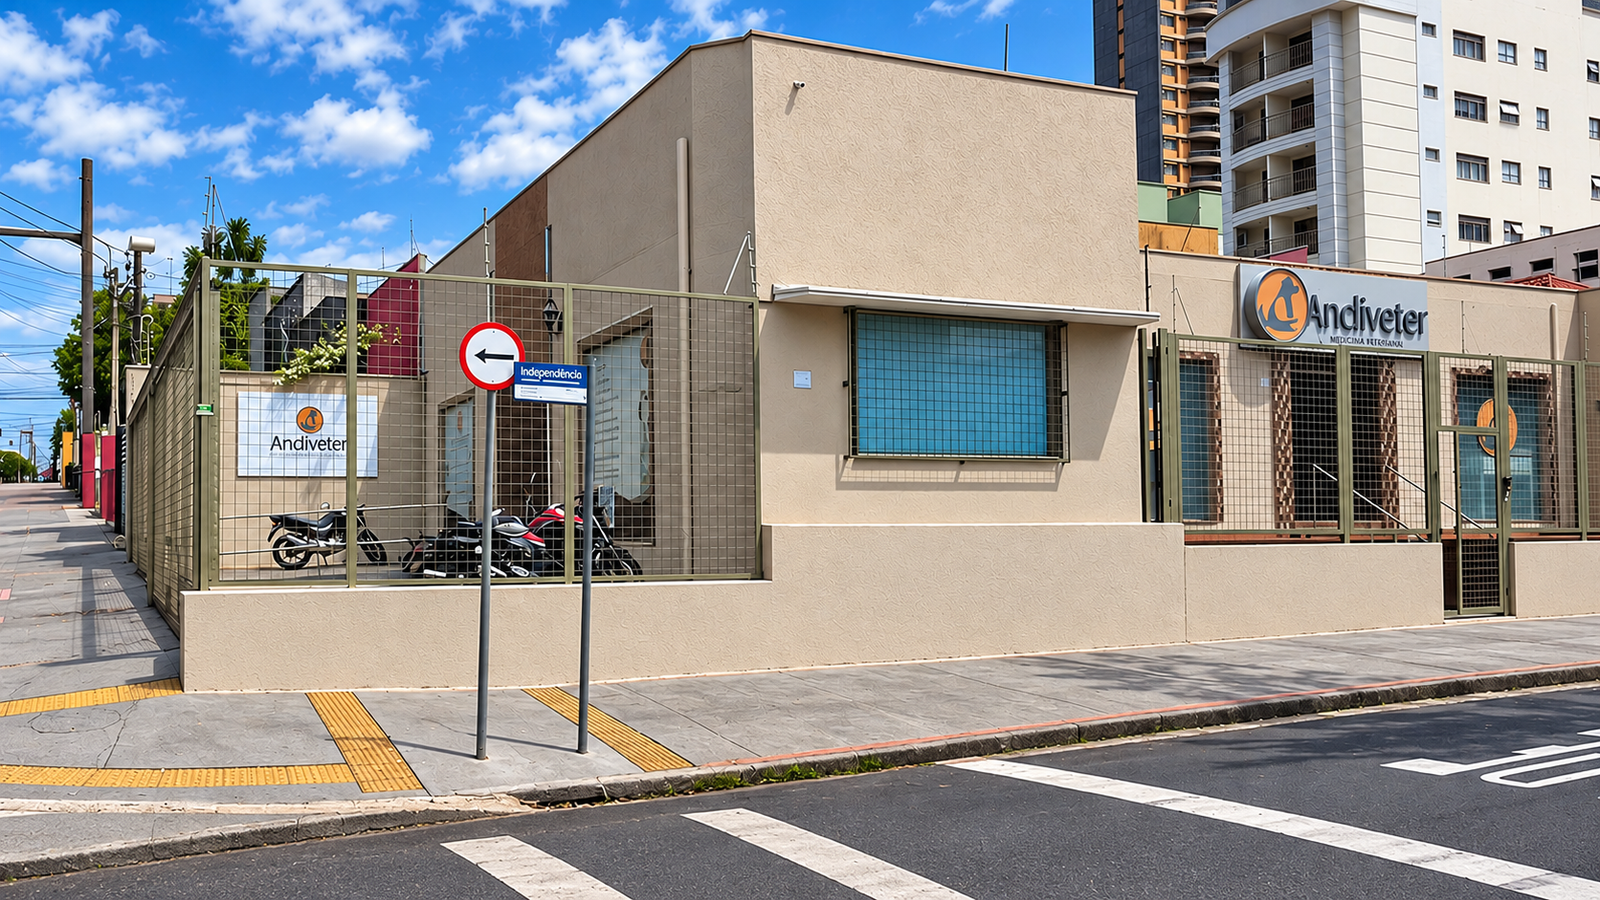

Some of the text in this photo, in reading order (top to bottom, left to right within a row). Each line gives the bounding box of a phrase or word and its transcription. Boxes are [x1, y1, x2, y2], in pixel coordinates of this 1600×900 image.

[1308, 294, 1428, 335] Andiveter
[520, 366, 582, 379] Independência
[270, 435, 347, 451] Andiveter
